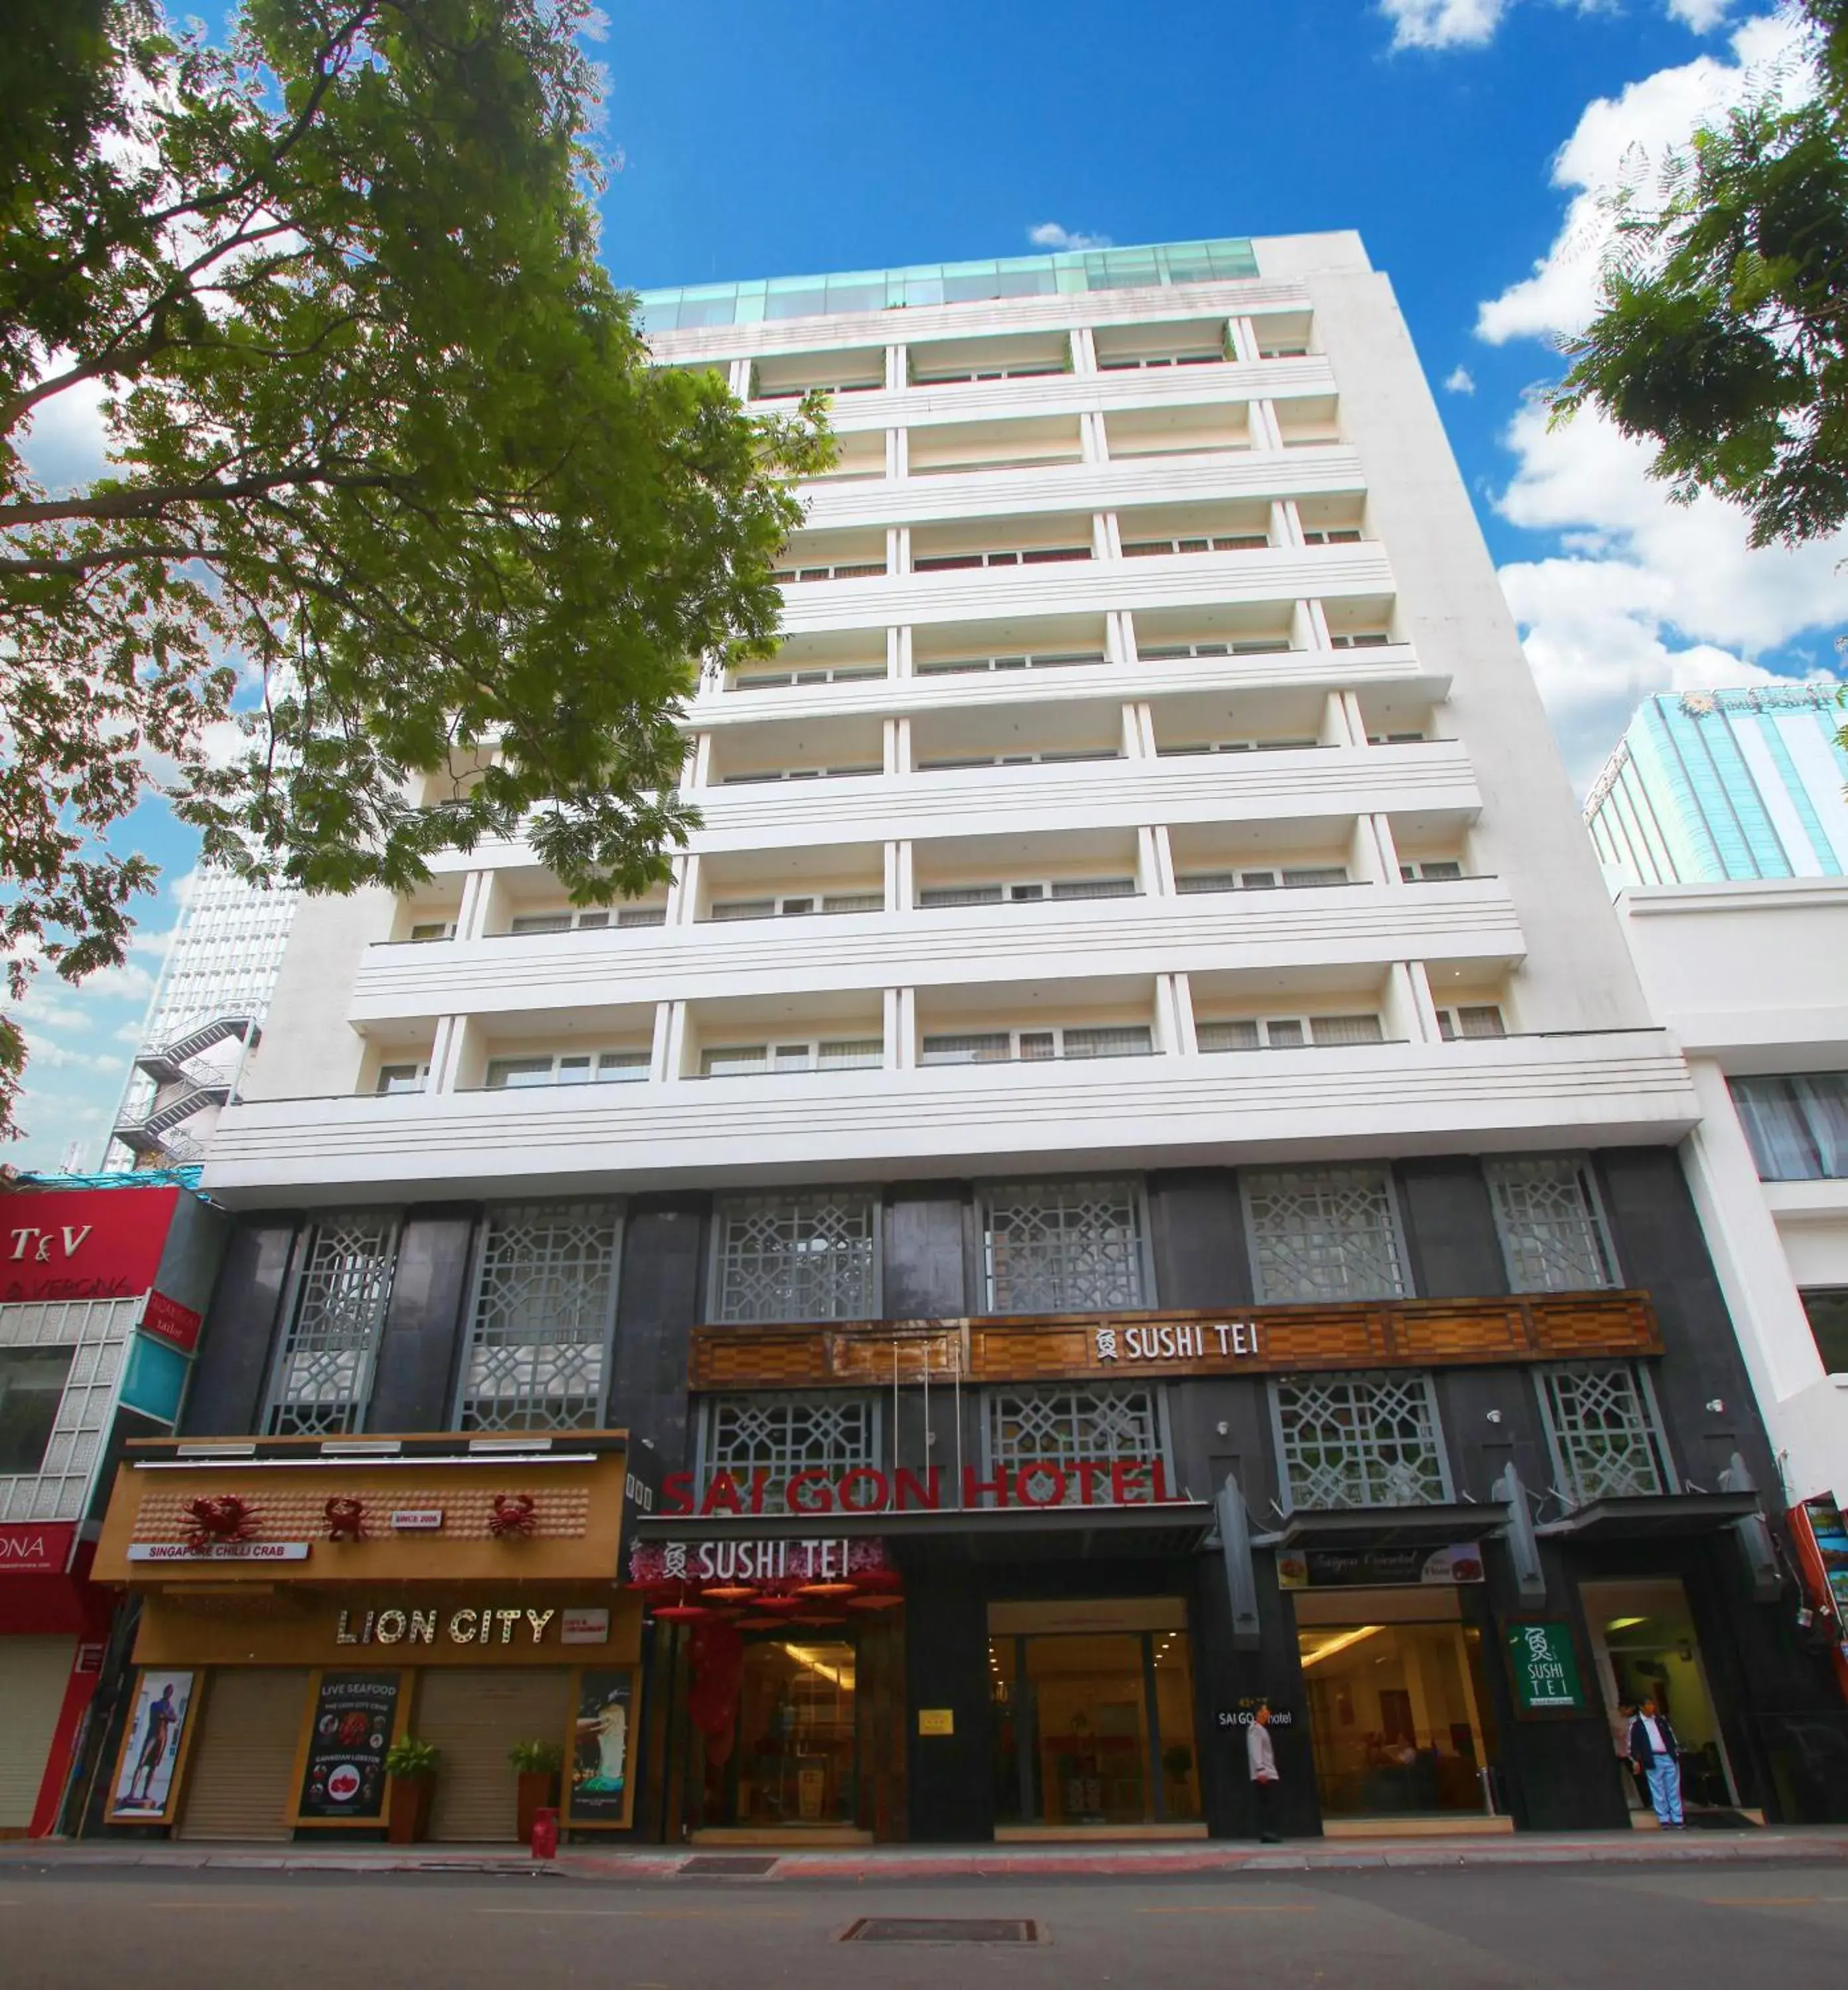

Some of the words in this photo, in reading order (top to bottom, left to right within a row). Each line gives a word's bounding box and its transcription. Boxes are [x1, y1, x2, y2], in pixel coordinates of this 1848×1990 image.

[9, 1225, 93, 1262] T&V
[1126, 1326, 1203, 1359] SUSHI
[1215, 1323, 1258, 1355] TEI
[659, 1468, 940, 1516] SAIGON
[963, 1461, 1190, 1508] HOTEL
[216, 1546, 251, 1557] CHILLI
[253, 1546, 285, 1556] CRAB
[699, 1540, 785, 1579] SUSHI
[801, 1539, 849, 1578] TEI
[336, 1609, 438, 1644] LION
[450, 1609, 555, 1644] CITY
[1528, 1663, 1563, 1679] SUSHI
[1530, 1680, 1567, 1695] TEI
[322, 1685, 345, 1695] LIVE
[347, 1684, 397, 1695] SEAFOOD
